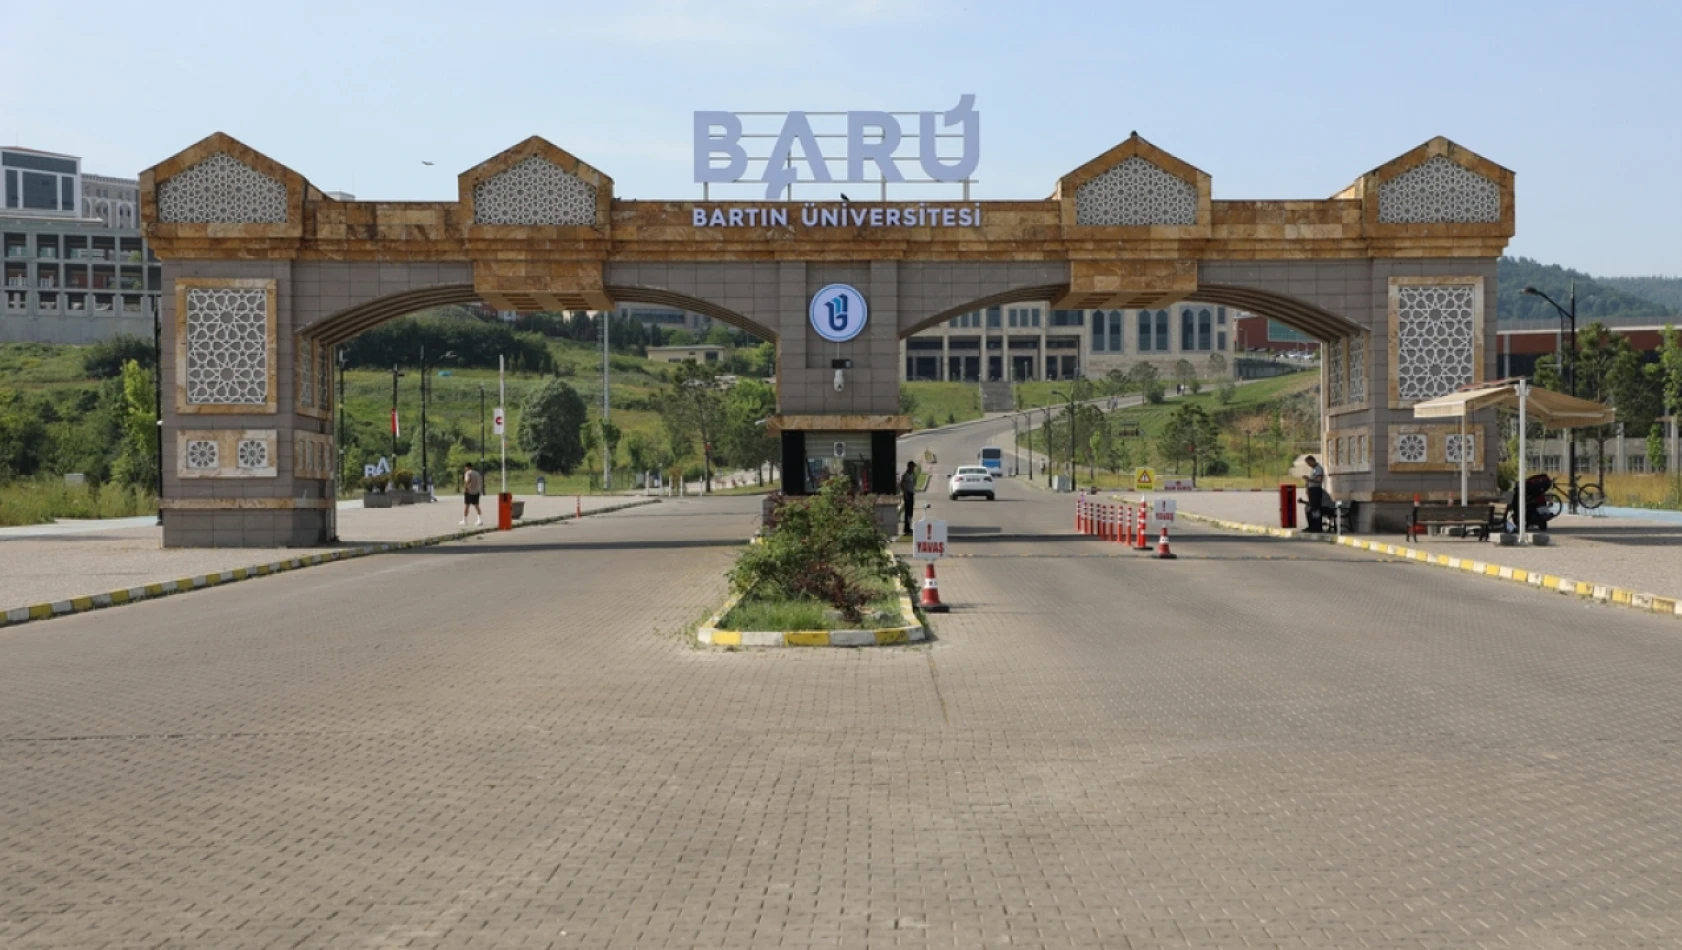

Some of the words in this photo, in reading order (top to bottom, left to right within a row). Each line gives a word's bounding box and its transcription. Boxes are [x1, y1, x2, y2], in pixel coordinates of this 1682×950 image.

[693, 207, 788, 227] BARTIN
[802, 203, 980, 227] ÜNİVERSİTESİ
[916, 541, 945, 557] YAVAŞ
